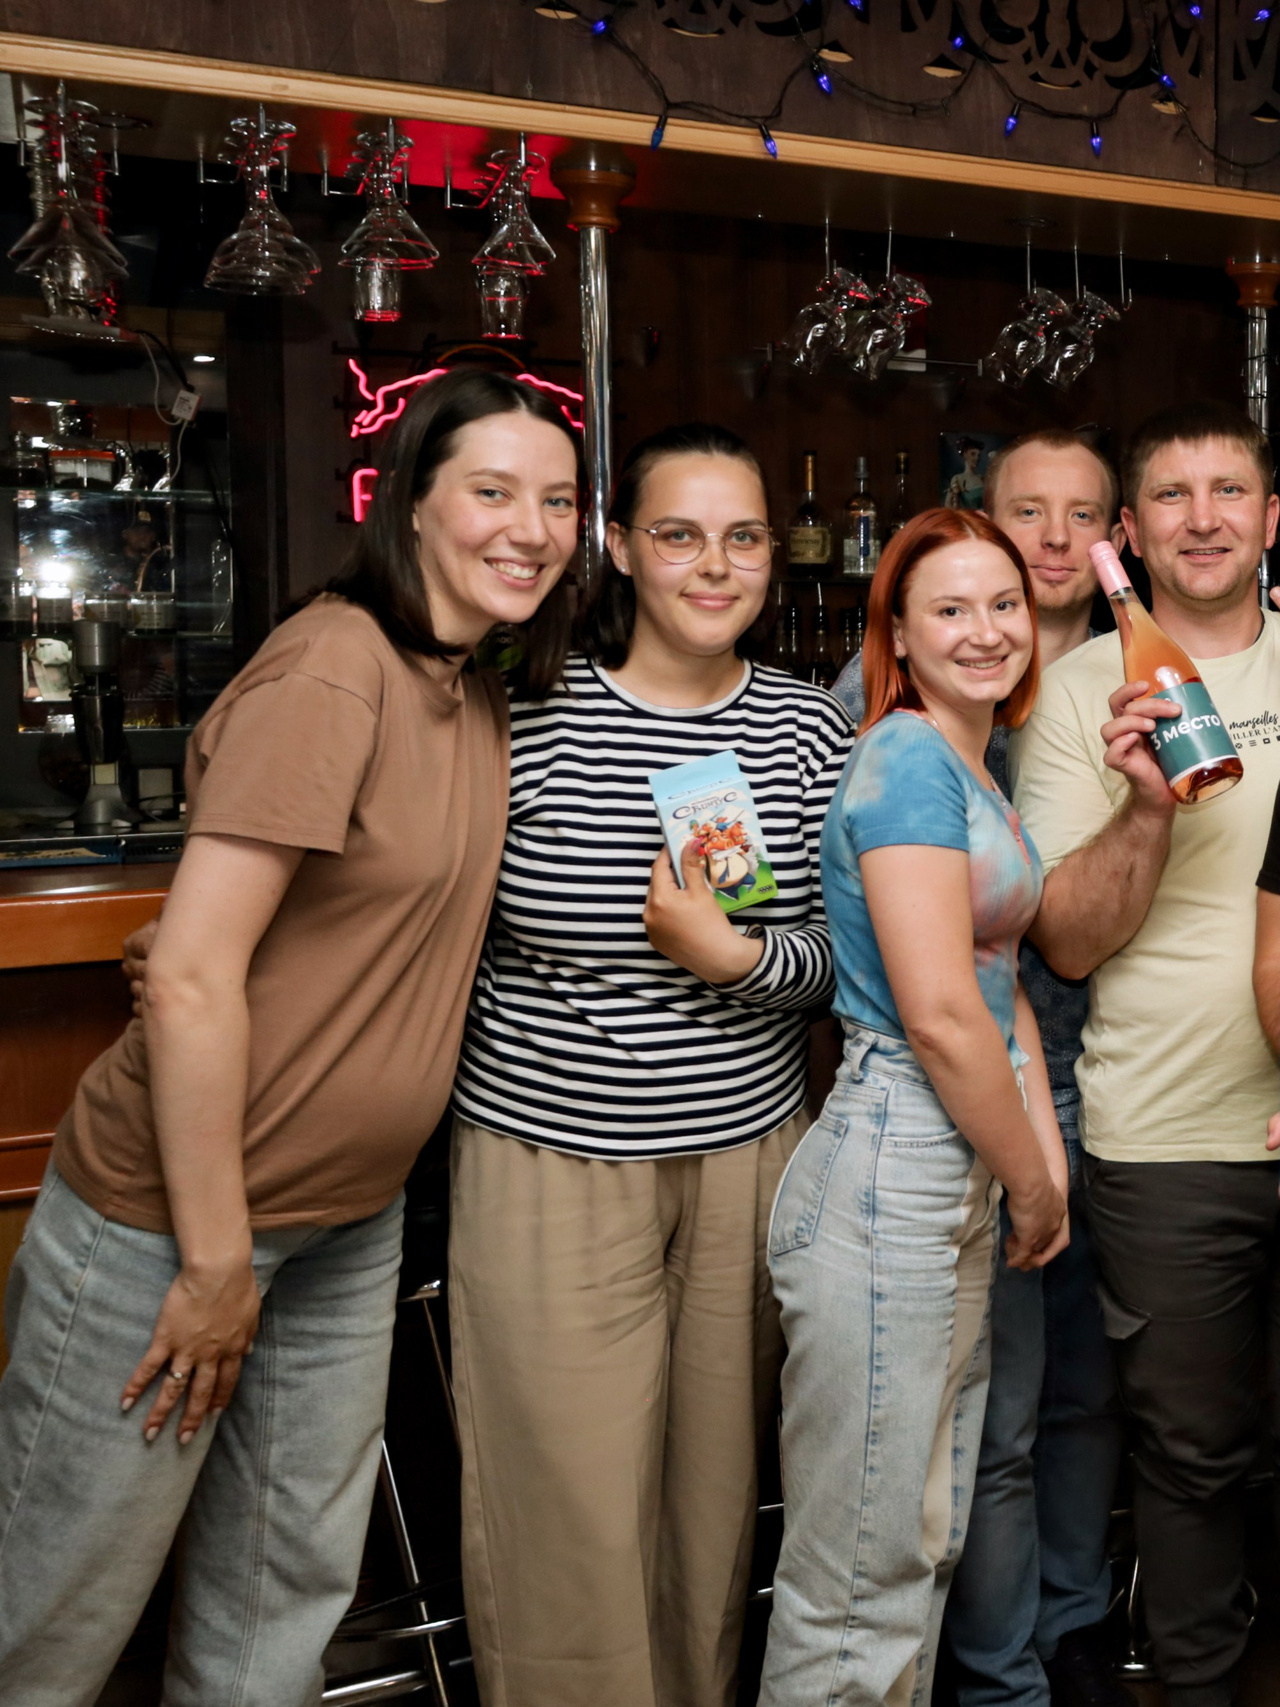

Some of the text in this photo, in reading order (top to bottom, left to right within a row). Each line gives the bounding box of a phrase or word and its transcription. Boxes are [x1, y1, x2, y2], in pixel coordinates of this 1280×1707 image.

[1229, 710, 1279, 730] marseilles
[1151, 733, 1161, 750] 3
[1231, 729, 1262, 741] ILLER
